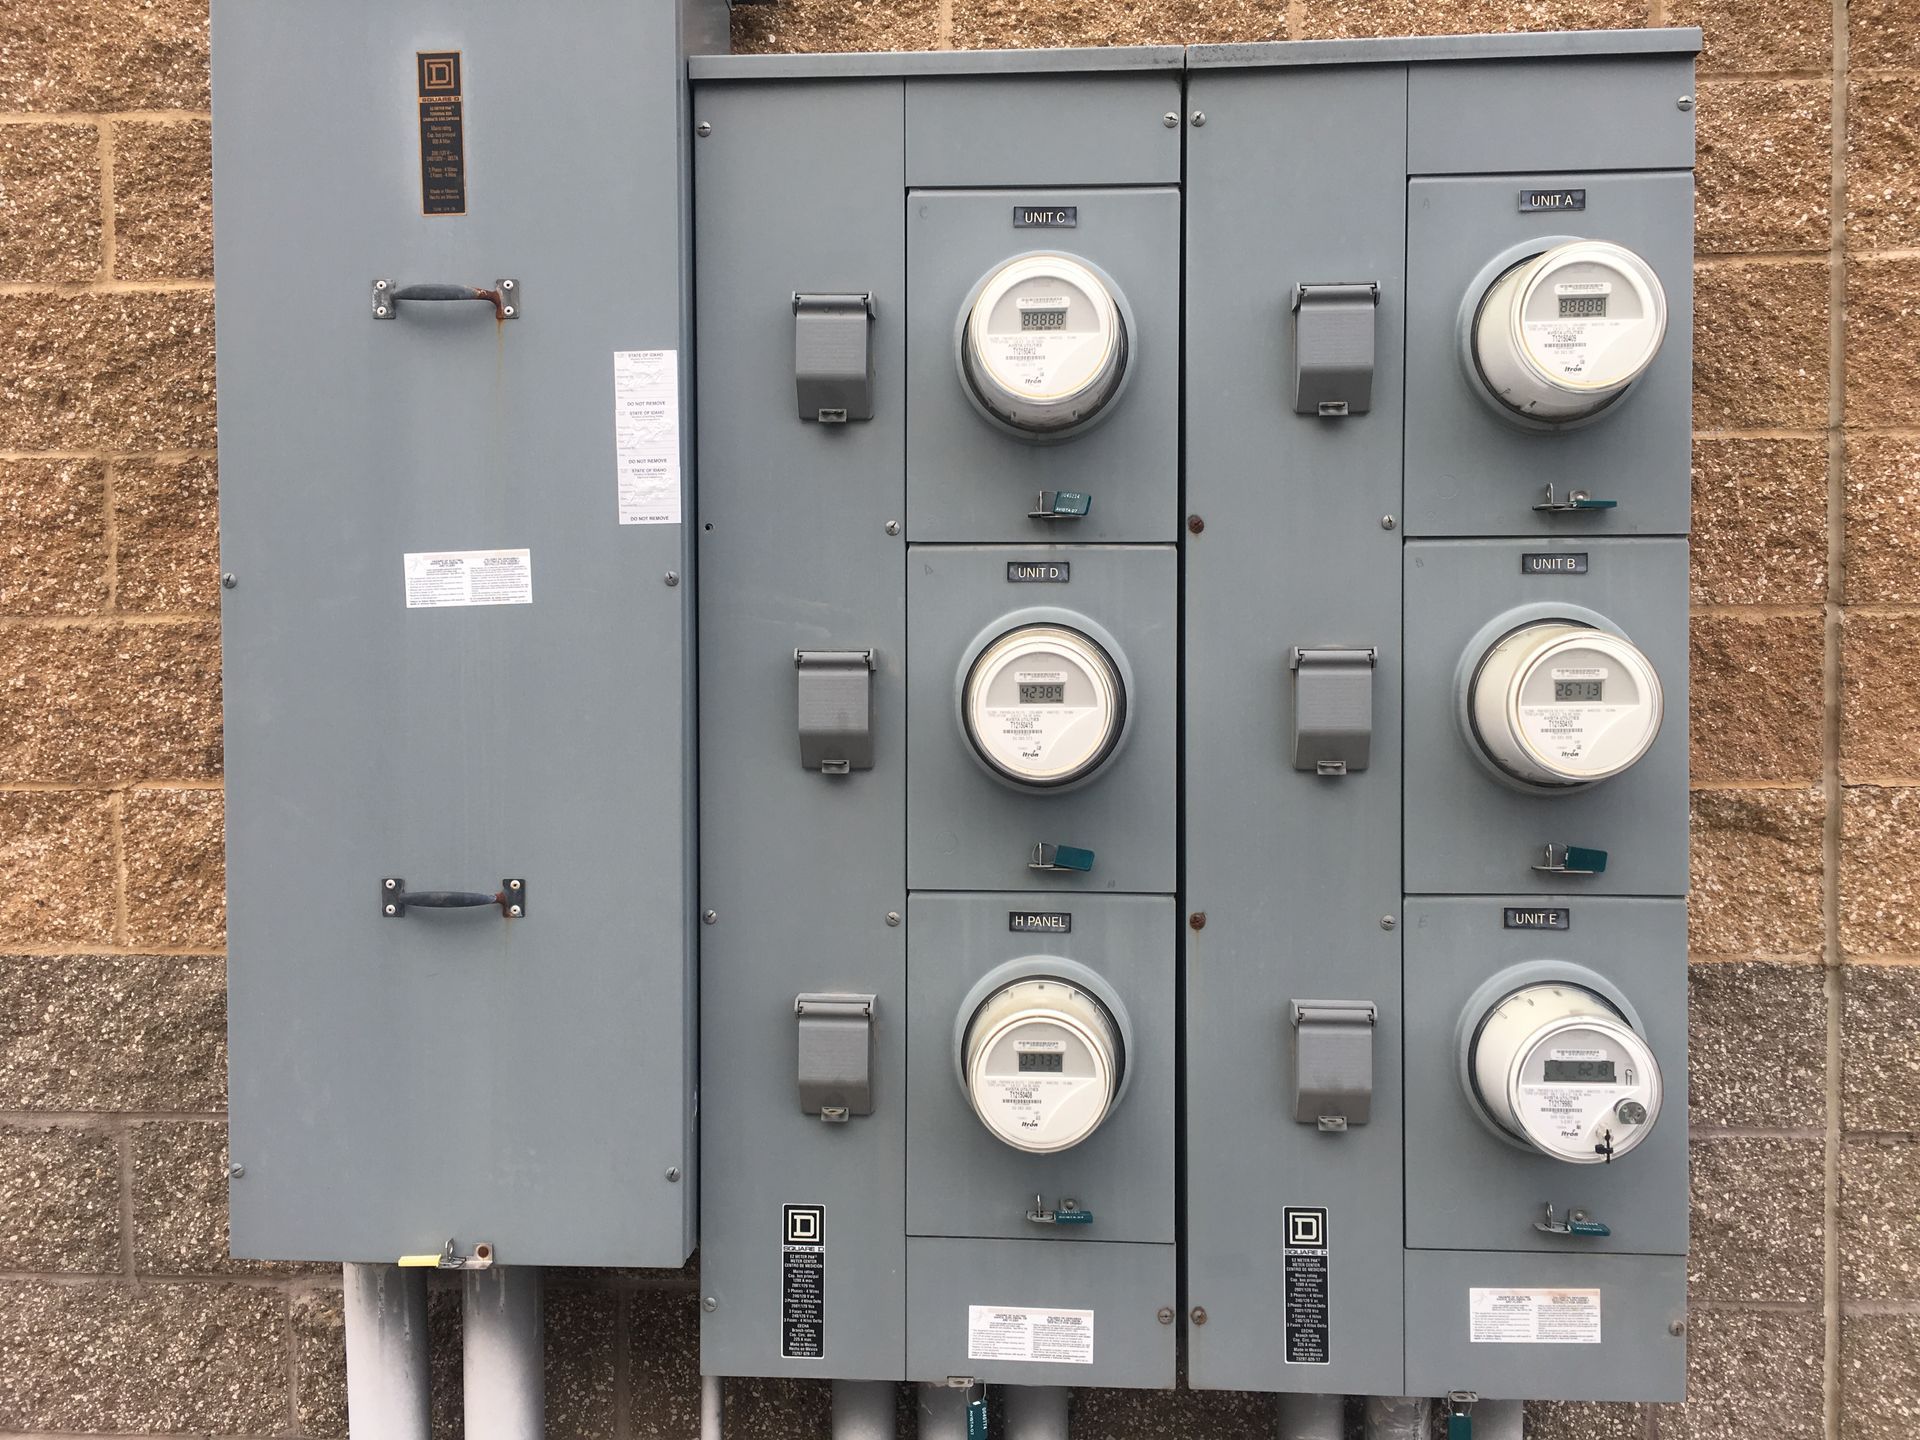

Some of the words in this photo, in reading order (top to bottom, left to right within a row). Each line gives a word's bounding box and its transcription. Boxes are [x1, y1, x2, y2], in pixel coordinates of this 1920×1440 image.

[1532, 194, 1562, 206] UNIT
[1564, 194, 1573, 206] A
[1025, 212, 1054, 223] UNIT
[1056, 212, 1066, 223] C
[1560, 300, 1604, 313] 88888
[1023, 313, 1064, 326] 88888
[1533, 558, 1563, 570] UNIT
[1568, 558, 1576, 570] B
[1018, 567, 1046, 578] UNIT
[1050, 567, 1058, 578] D
[1021, 686, 1062, 699] 42389
[1556, 684, 1600, 696] 26713
[1016, 916, 1024, 926] H
[1028, 916, 1066, 928] PANEL
[1516, 913, 1546, 924] UNIT
[1550, 913, 1557, 924] E
